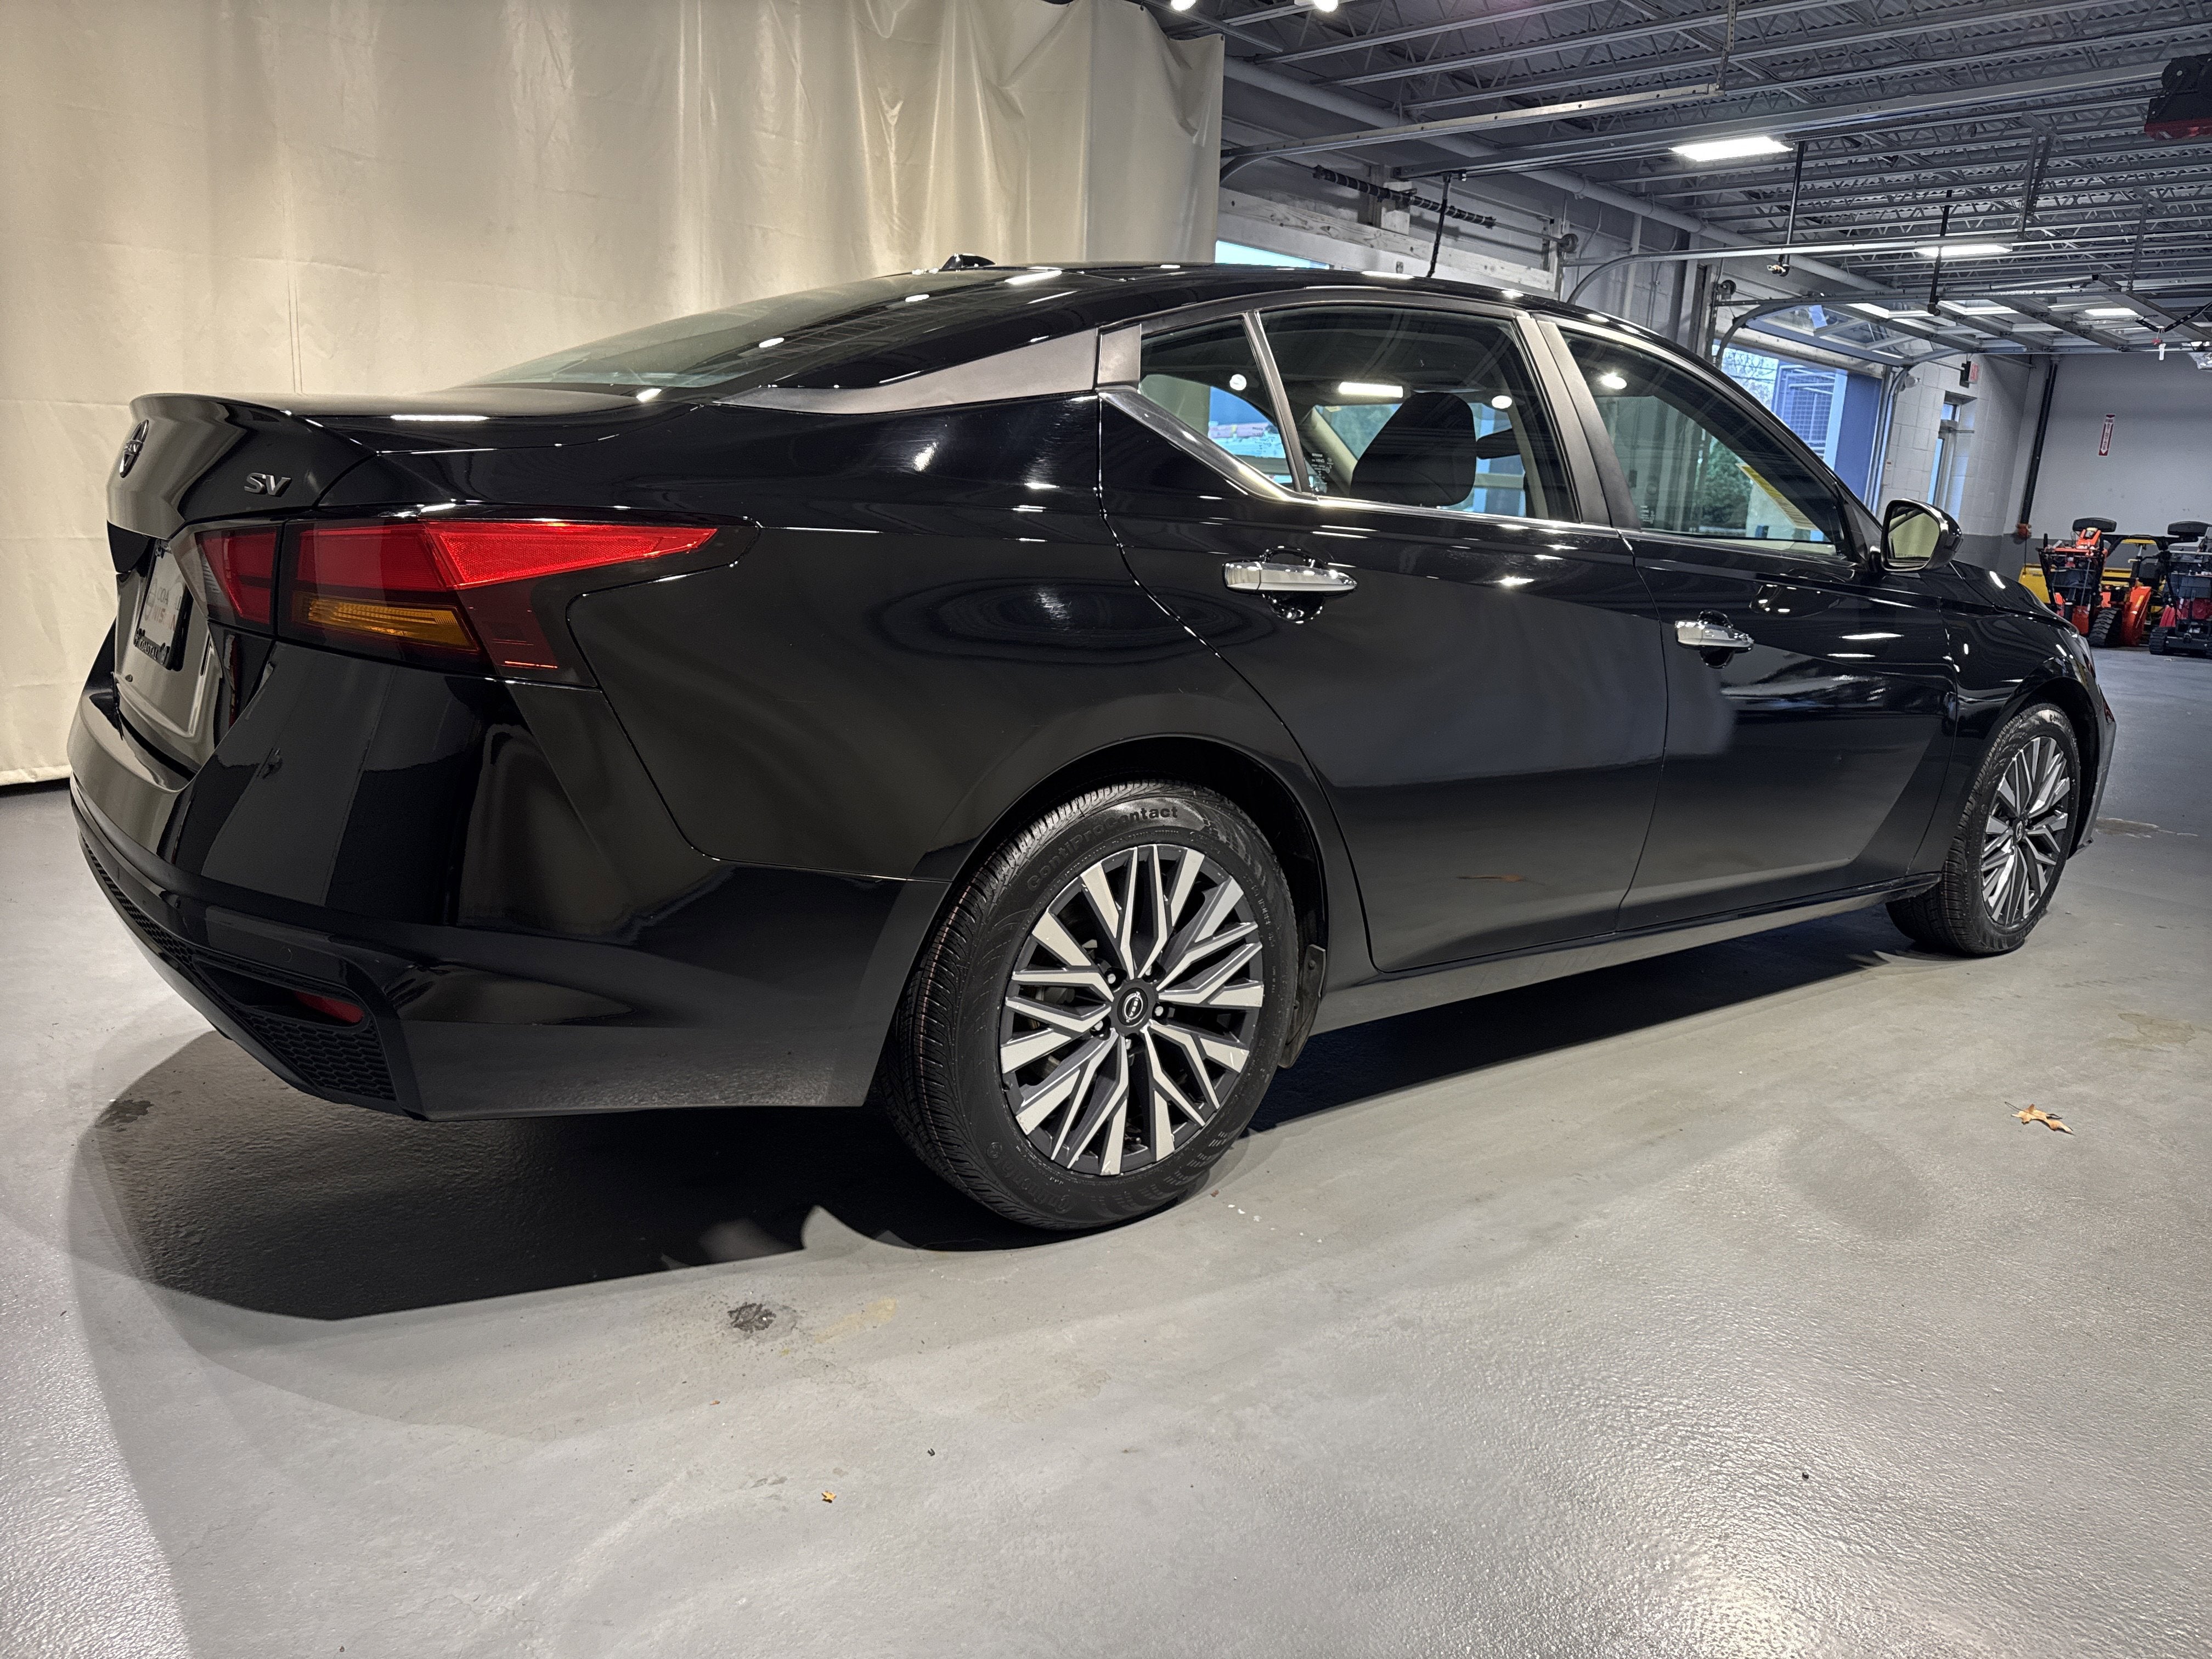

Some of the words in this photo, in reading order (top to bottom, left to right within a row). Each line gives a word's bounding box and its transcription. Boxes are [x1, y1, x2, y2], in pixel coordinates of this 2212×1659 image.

[244, 472, 291, 496] SV
[139, 639, 158, 661] COASTAL
[1028, 805, 1178, 891] ContiProContact
